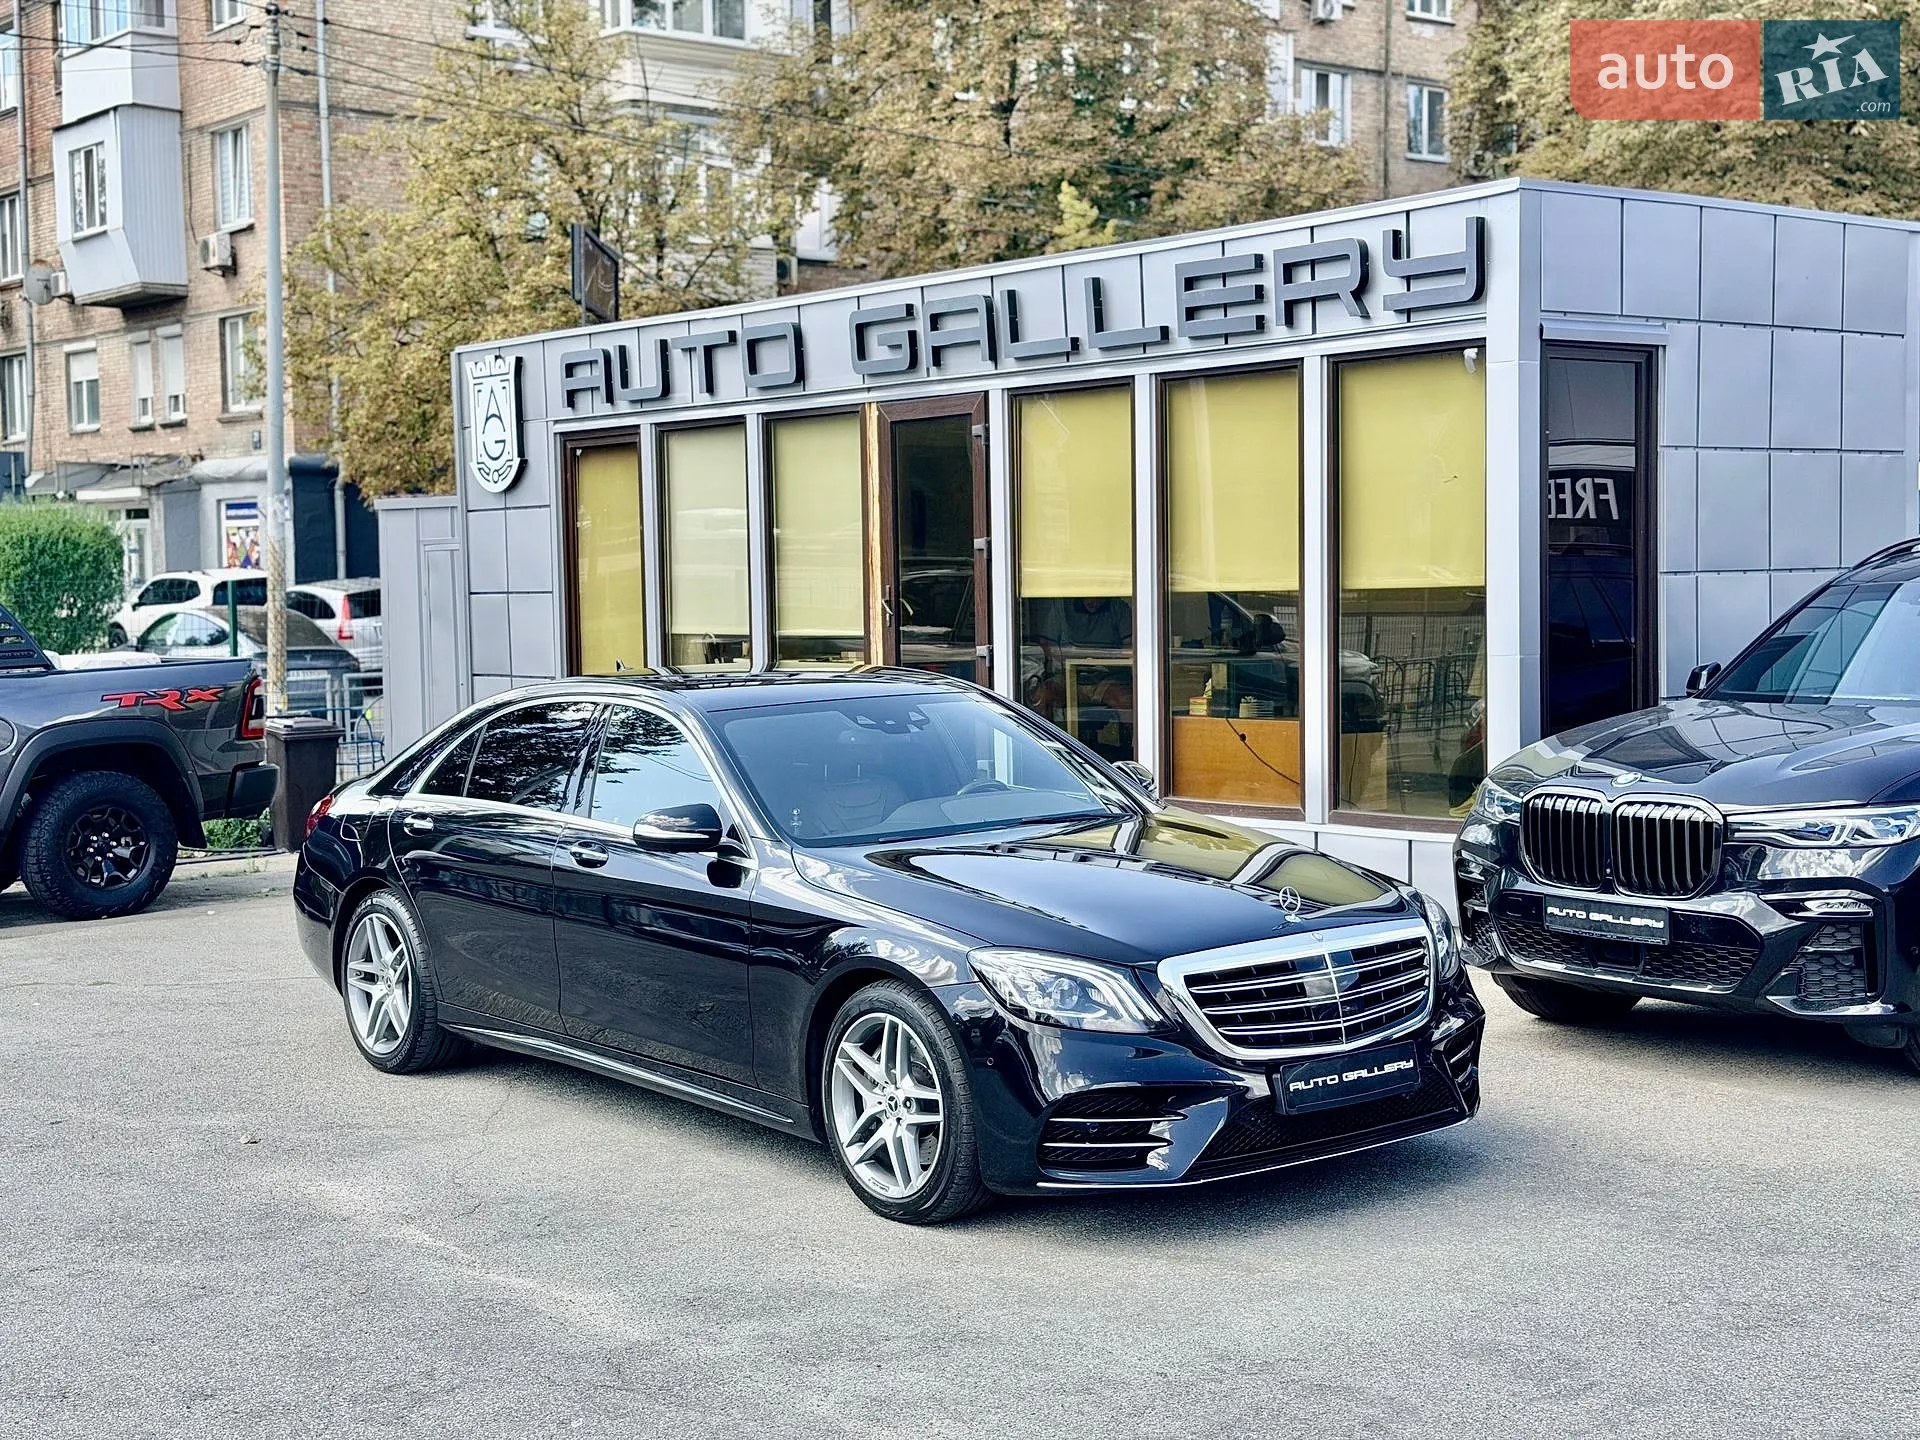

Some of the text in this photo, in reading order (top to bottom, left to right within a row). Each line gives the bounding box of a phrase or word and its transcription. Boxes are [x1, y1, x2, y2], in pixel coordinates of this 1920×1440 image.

[560, 216, 1486, 409] AUTO GALLERY
[102, 687, 226, 712] TRX
[1546, 906, 1664, 929] AUTO GALLERY
[1289, 1058, 1414, 1092] AUTO GALLERY
